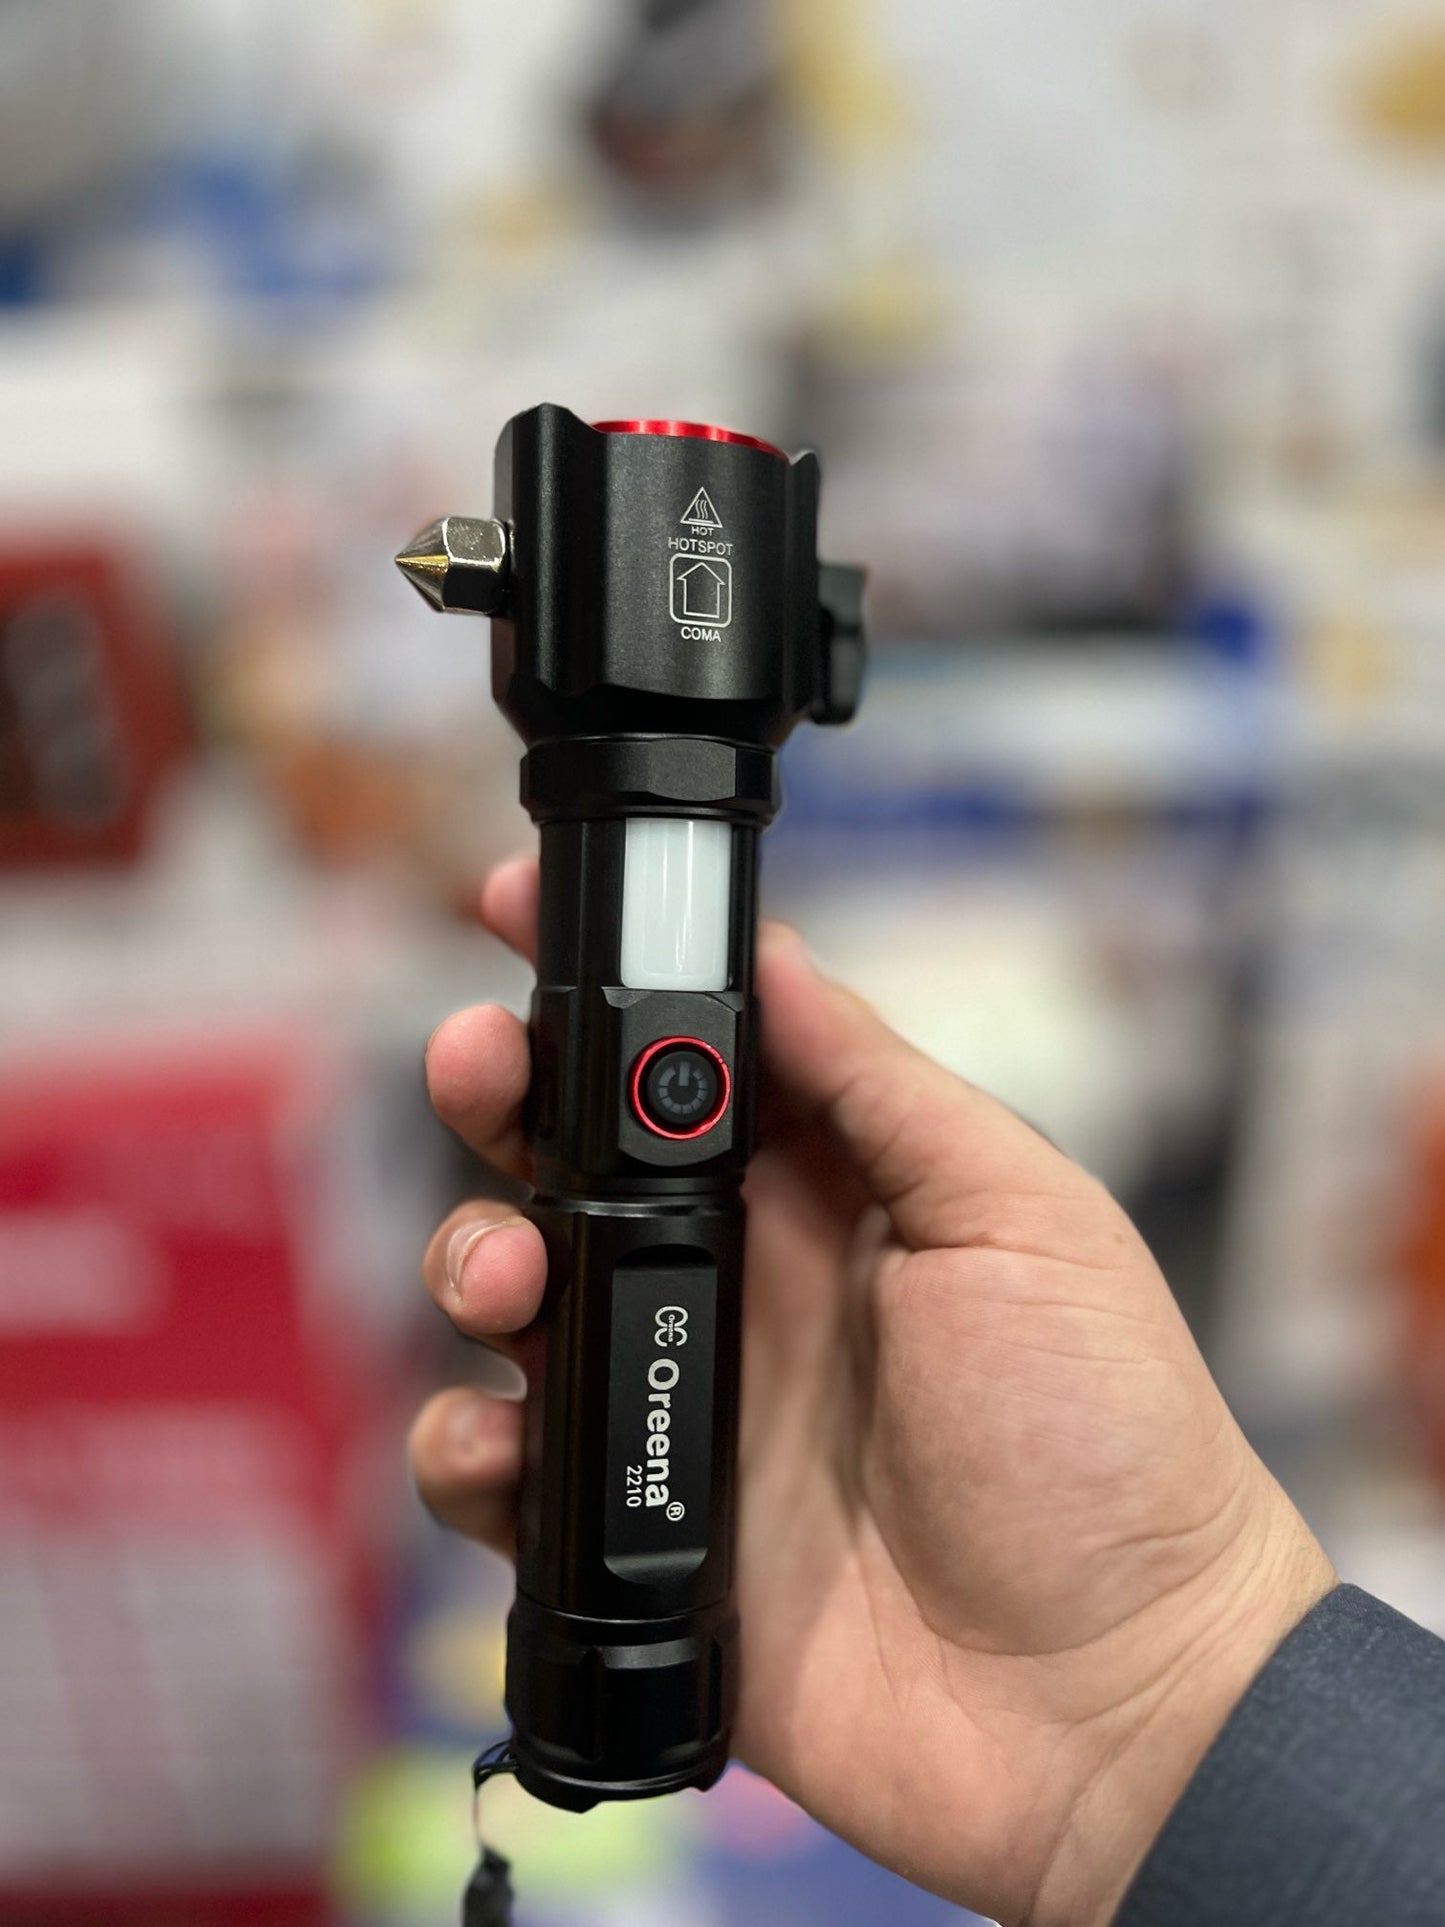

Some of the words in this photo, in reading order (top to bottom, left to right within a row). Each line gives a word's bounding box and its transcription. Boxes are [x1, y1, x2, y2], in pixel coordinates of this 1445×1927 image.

[691, 526, 714, 536] HOT
[667, 537, 734, 556] HOTSPOT
[680, 626, 722, 643] COMA
[626, 1464, 643, 1508] 2210
